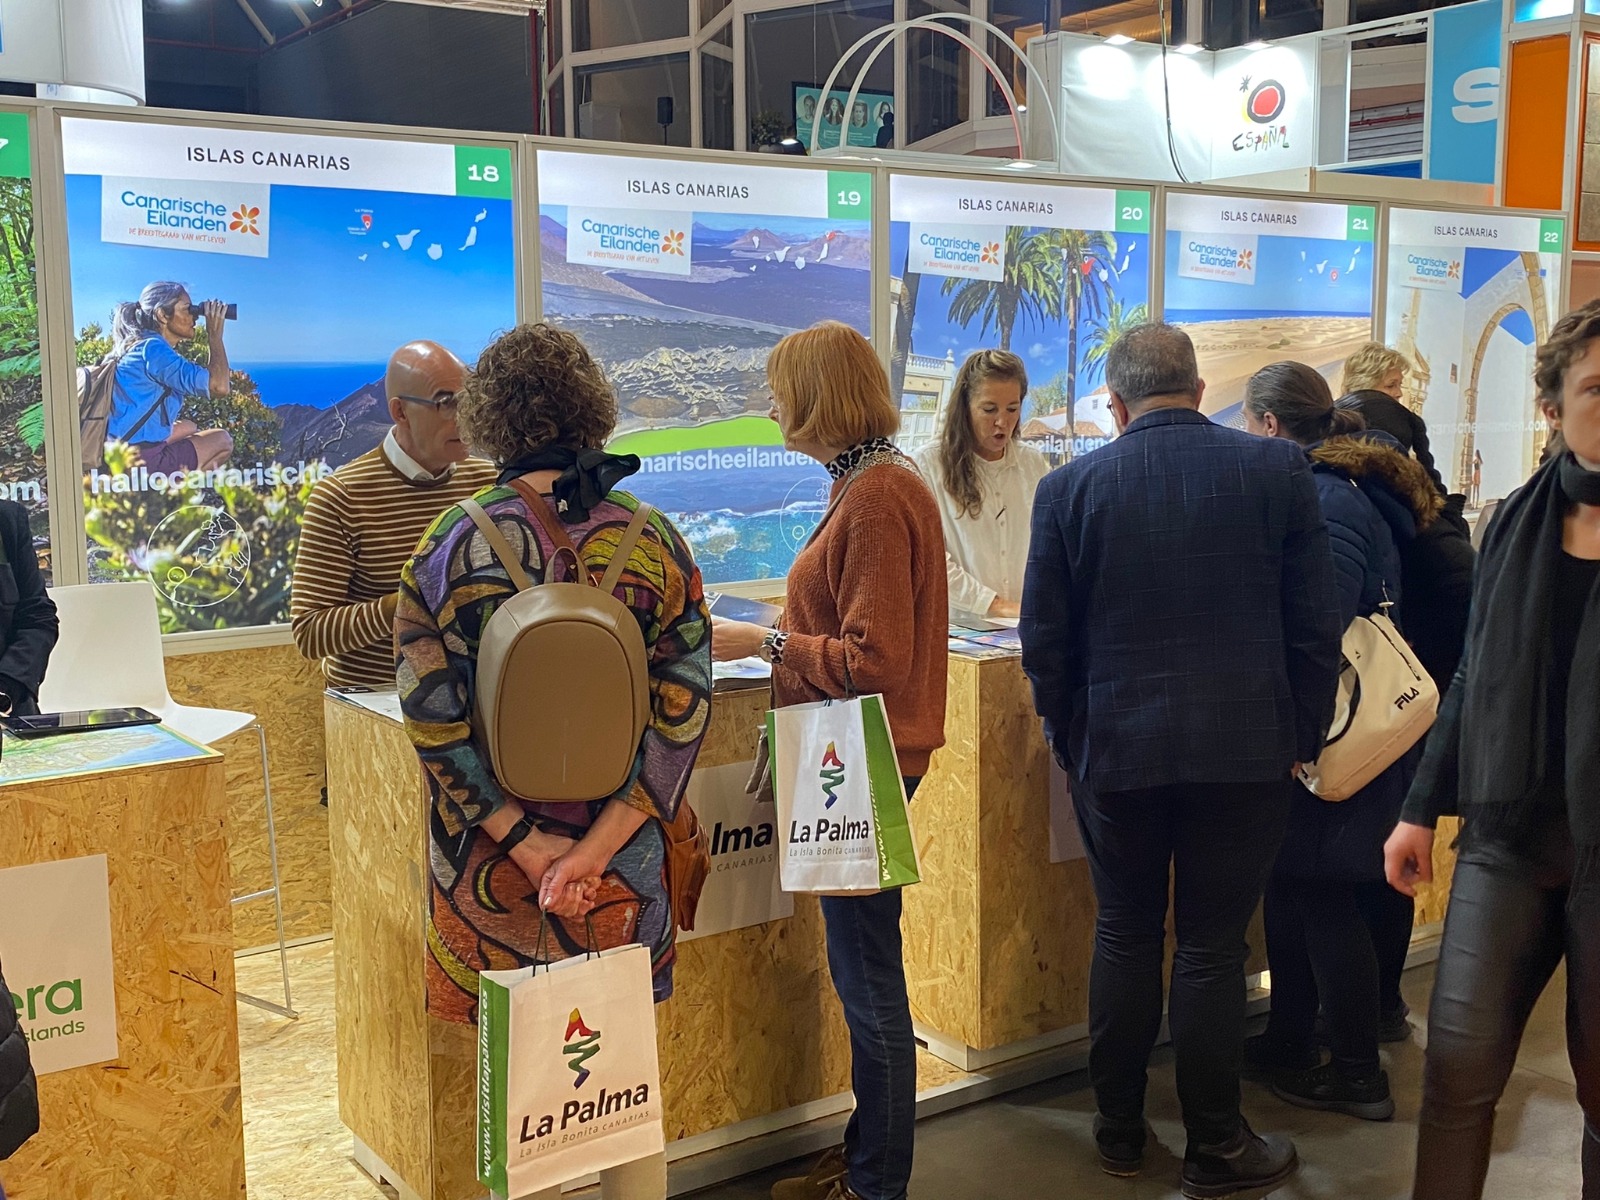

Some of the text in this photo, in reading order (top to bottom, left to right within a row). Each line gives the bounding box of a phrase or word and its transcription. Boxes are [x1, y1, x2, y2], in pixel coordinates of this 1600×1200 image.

[1232, 125, 1290, 153] ESPAÑA
[187, 147, 351, 171] ISLAS CANARIAS
[467, 164, 500, 182] 18
[627, 180, 749, 199] ISLAS CANARIAS
[837, 190, 861, 206] 19
[121, 190, 226, 217] Canarische
[959, 198, 1053, 214] ISLAS CANARIAS
[147, 209, 226, 232] Eilanden
[1122, 207, 1143, 221] 20
[1221, 210, 1297, 225] ISLAS CANARIAS
[581, 218, 660, 241] Canarische
[1352, 218, 1369, 230] 21
[1434, 225, 1498, 239] ISLAS CANARIAS
[600, 234, 660, 254] Eilanden
[920, 233, 981, 251] Canarische
[1543, 232, 1559, 243] 22
[934, 247, 980, 263] Eilanden
[1188, 241, 1238, 258] Canarische
[1199, 253, 1237, 268] Eilanden
[1394, 686, 1421, 710] FILA
[711, 821, 773, 856] lma
[789, 815, 869, 843] La Palma
[789, 848, 798, 857] La
[799, 847, 813, 857] Isla
[817, 846, 842, 856] Bonita
[716, 853, 773, 872] CANARIAS
[481, 987, 492, 1178] www.visitlapalma.es
[519, 1083, 649, 1144] La Palma
[520, 1110, 650, 1158] La Isla Bonita CANARIAS
